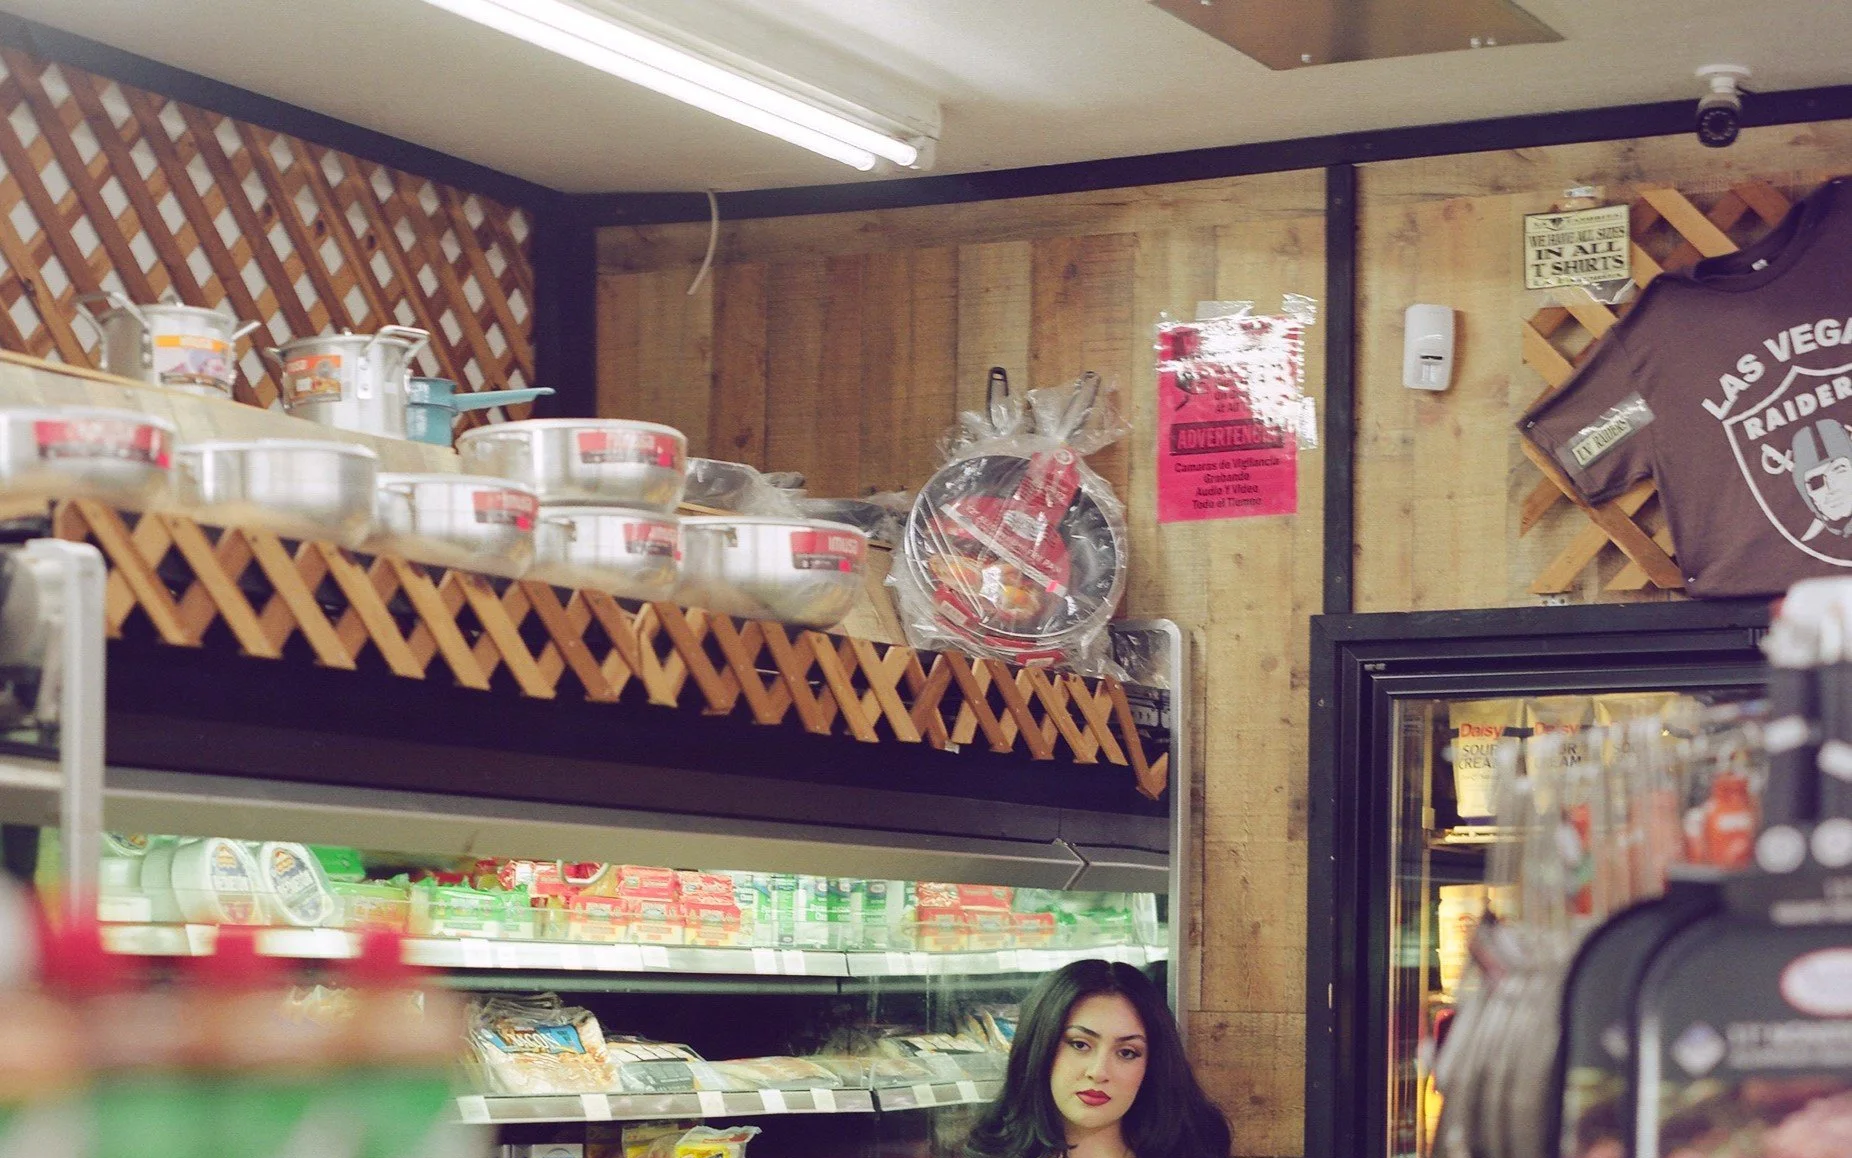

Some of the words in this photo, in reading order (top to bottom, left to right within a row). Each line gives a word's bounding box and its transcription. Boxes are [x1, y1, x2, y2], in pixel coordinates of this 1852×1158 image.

[1535, 247, 1563, 260] IN
[1572, 241, 1622, 257] ALL
[1531, 263, 1546, 278] T
[1551, 254, 1625, 276] SHIRTS
[1701, 353, 1766, 421] LAS
[1174, 461, 1217, 473] Camaras
[1219, 460, 1231, 470] de
[1233, 456, 1280, 471] Vigilancia
[1203, 471, 1250, 484] Grabando
[1195, 486, 1222, 497] Audio
[1233, 484, 1258, 494] Video
[1192, 499, 1214, 510] Todo
[1216, 498, 1226, 508] el
[1228, 496, 1262, 508] Tiempo
[1459, 722, 1505, 739] Daisy
[1458, 757, 1493, 770] CREA
